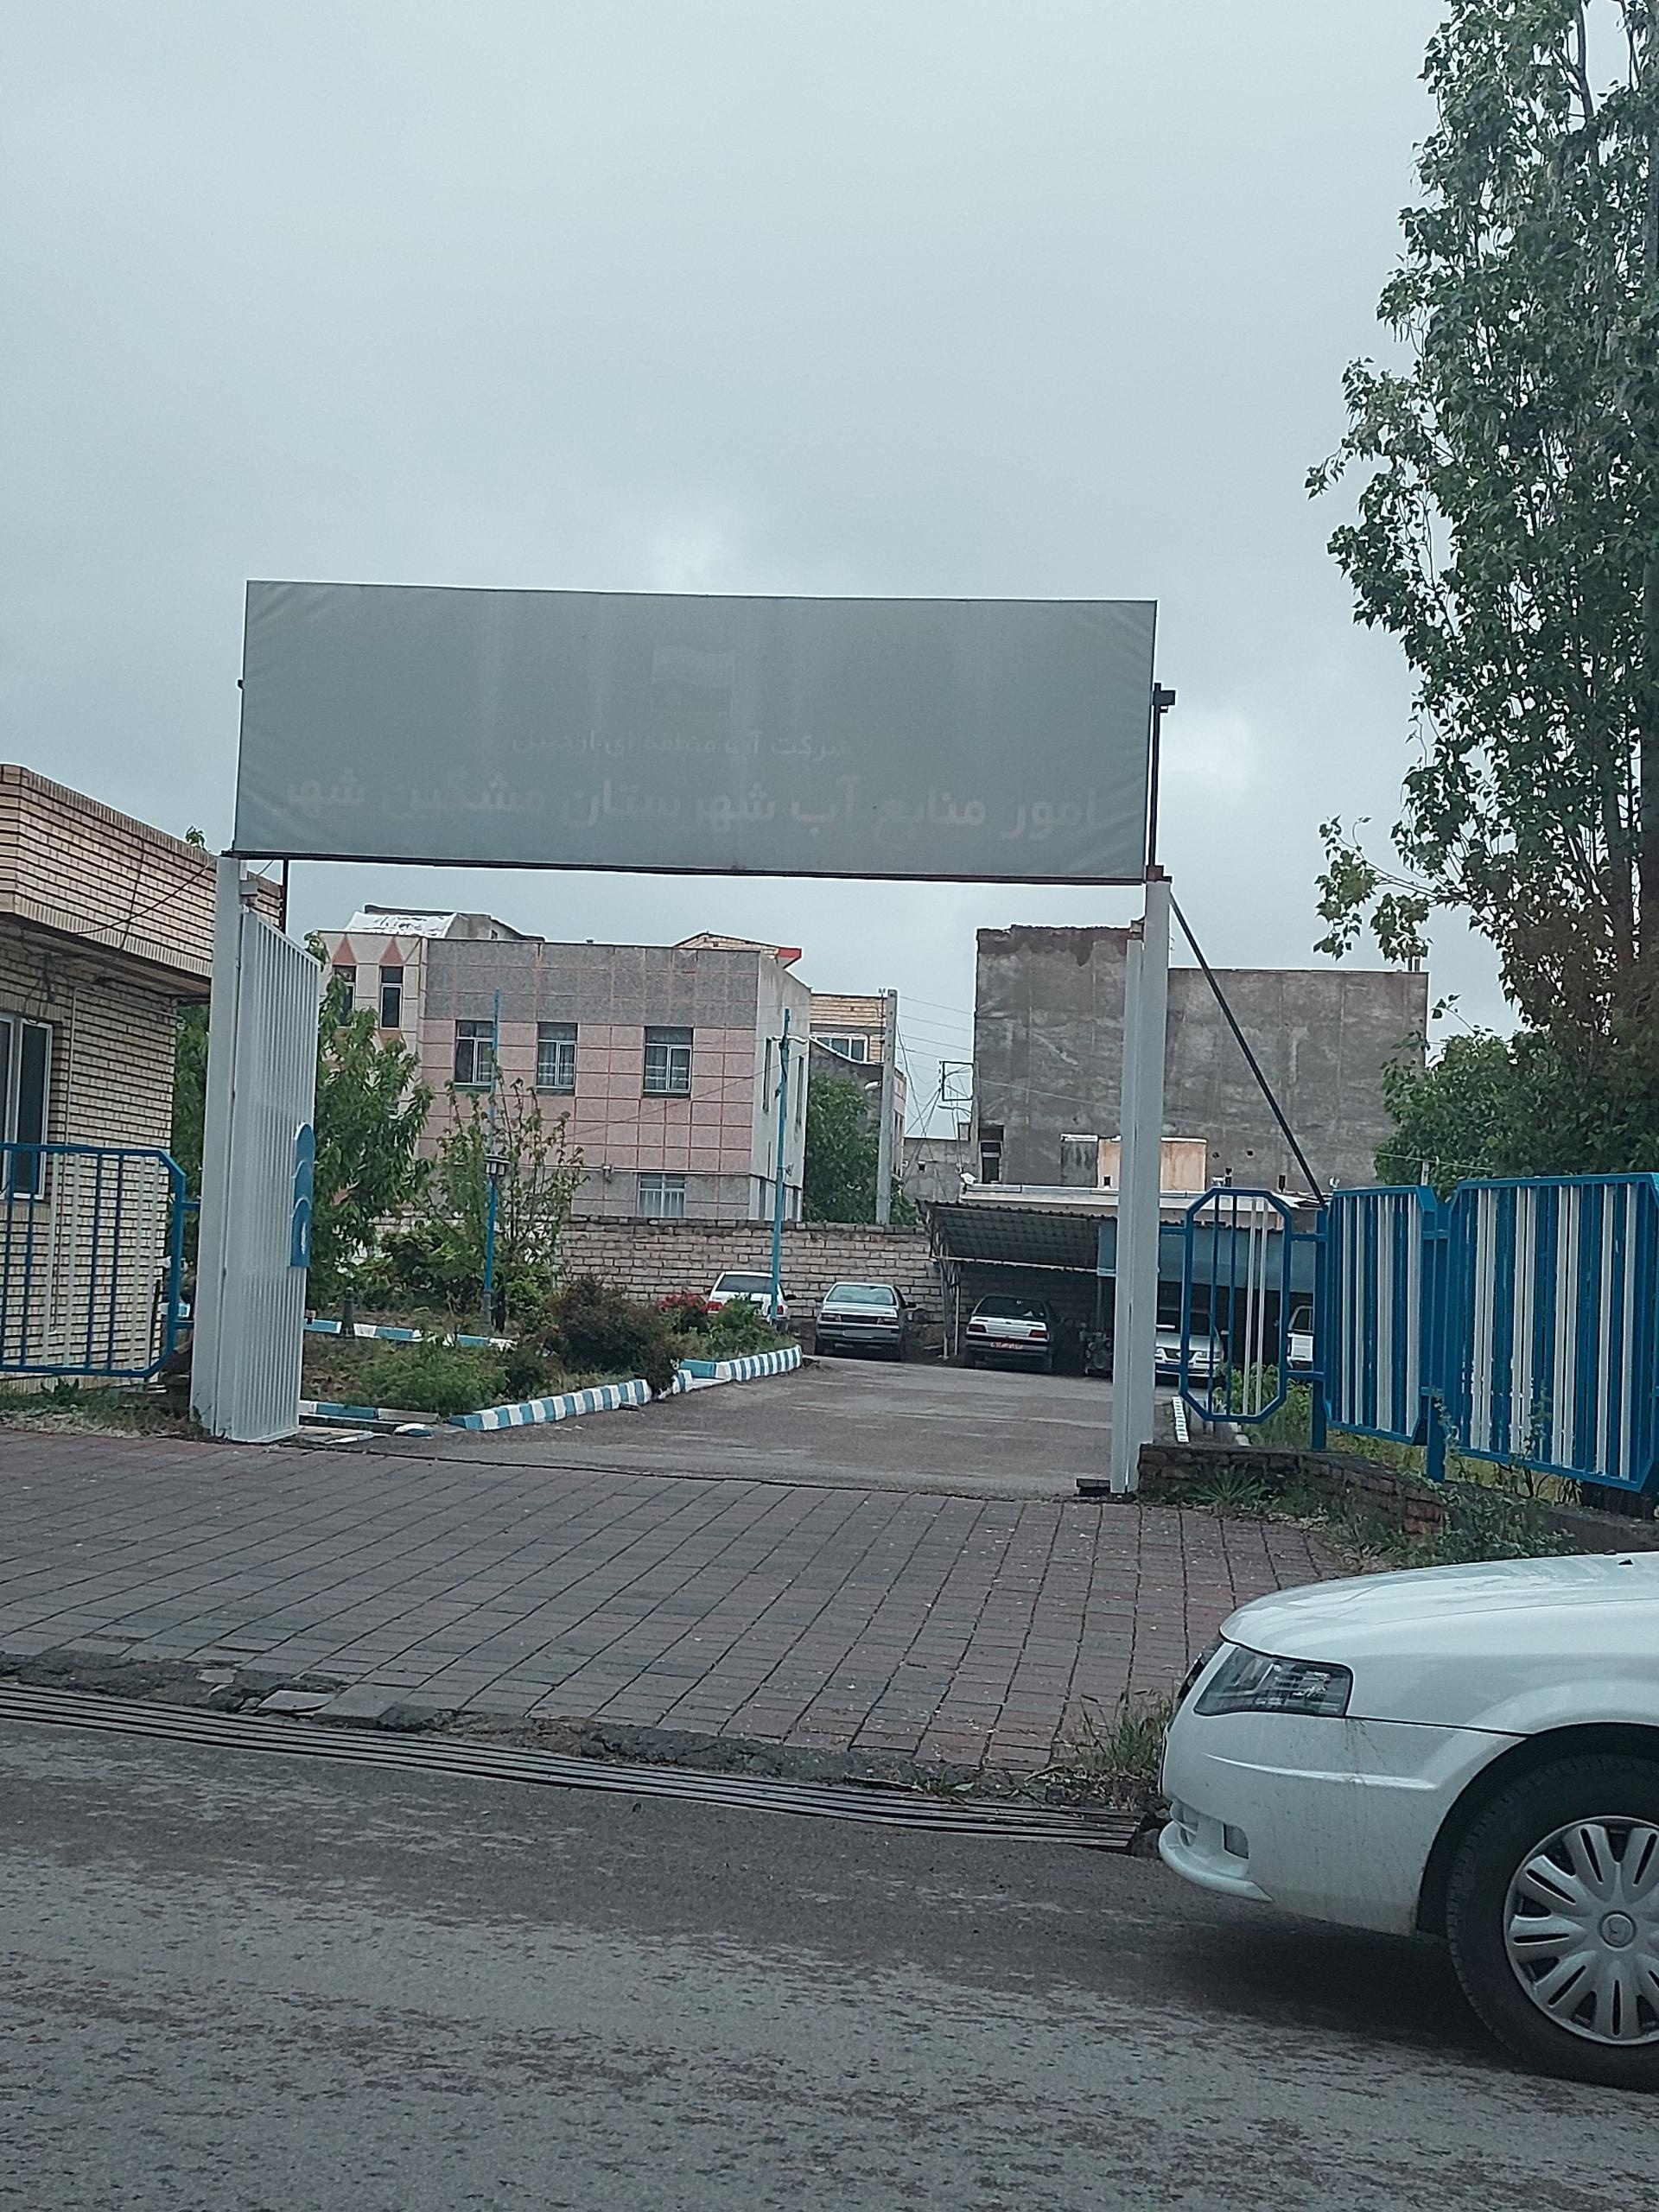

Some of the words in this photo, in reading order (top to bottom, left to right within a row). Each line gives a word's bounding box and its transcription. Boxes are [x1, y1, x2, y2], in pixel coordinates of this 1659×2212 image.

[790, 774, 863, 836] آب
[873, 786, 986, 851] منابع
[1001, 787, 1096, 841] امور
